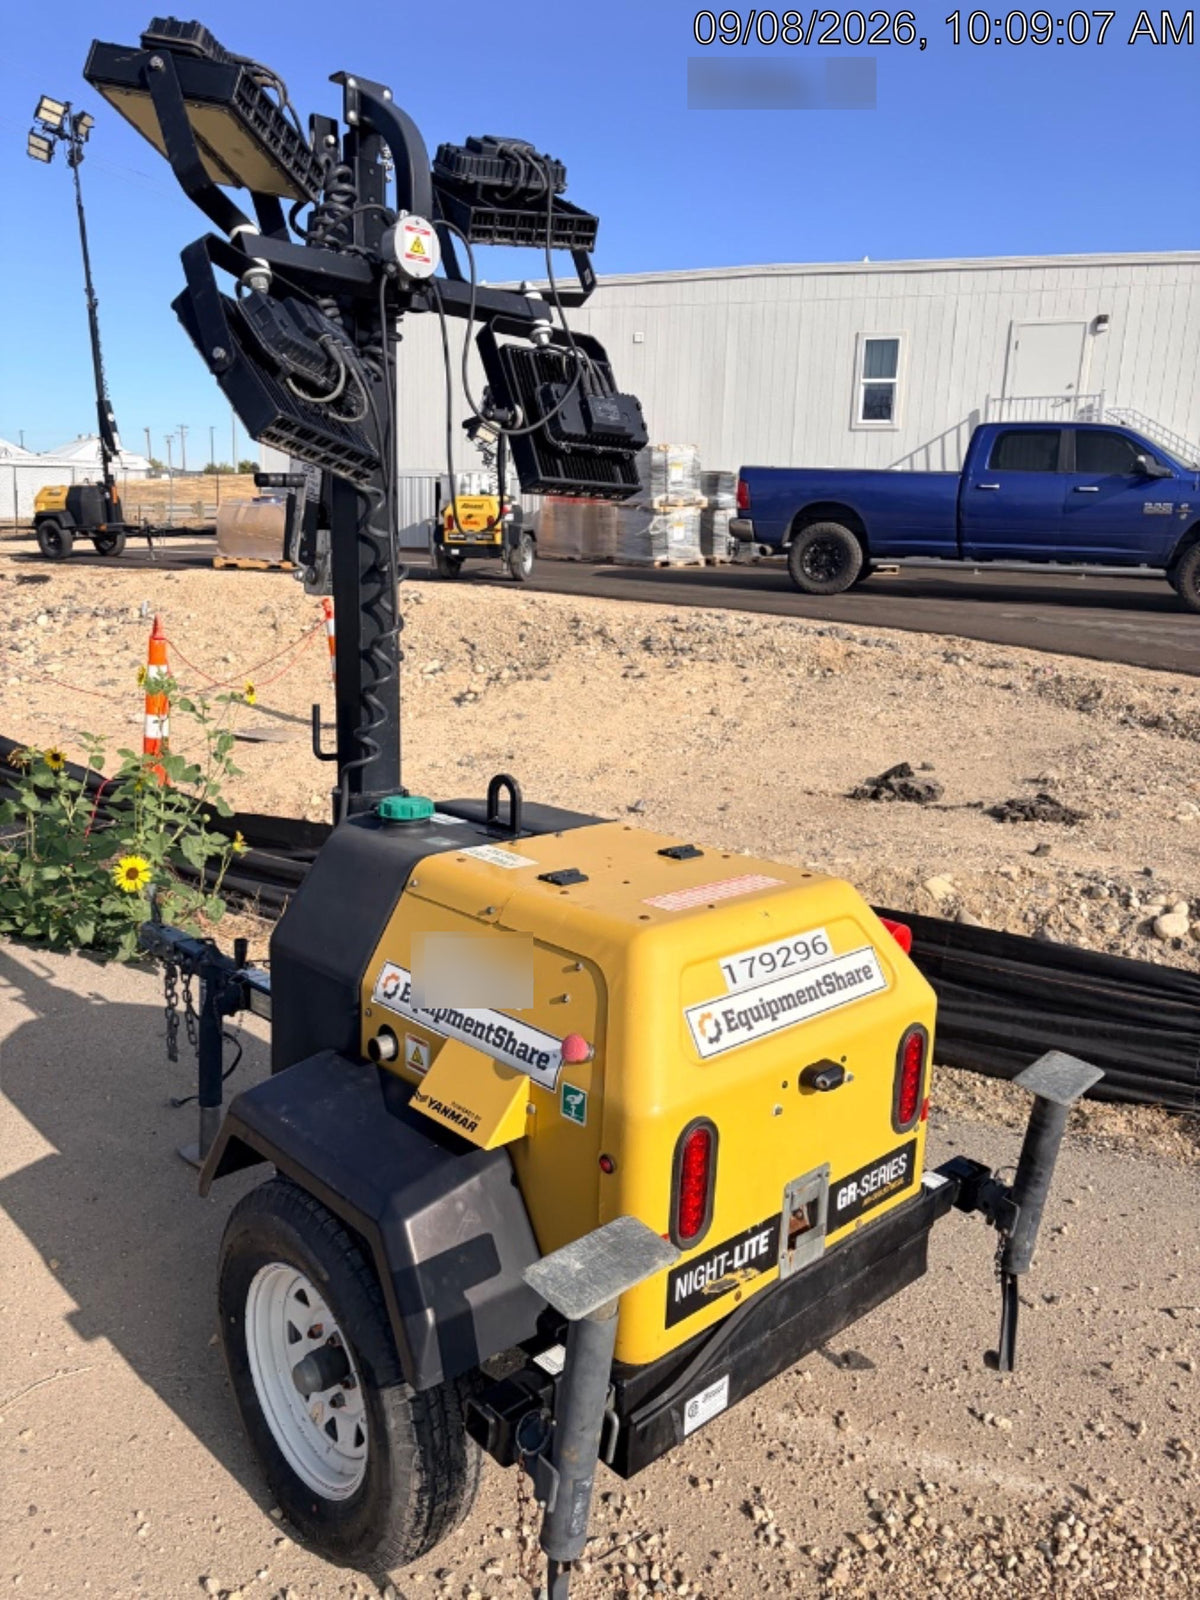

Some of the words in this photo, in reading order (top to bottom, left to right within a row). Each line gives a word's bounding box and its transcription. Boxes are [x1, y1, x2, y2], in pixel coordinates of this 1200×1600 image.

[721, 934, 828, 985] 179296
[721, 963, 874, 1033] EquipmentShare
[427, 1097, 478, 1133] YANMAR
[836, 1153, 908, 1211] GR-SERIES
[674, 1229, 771, 1303] NIGHT-LITE
